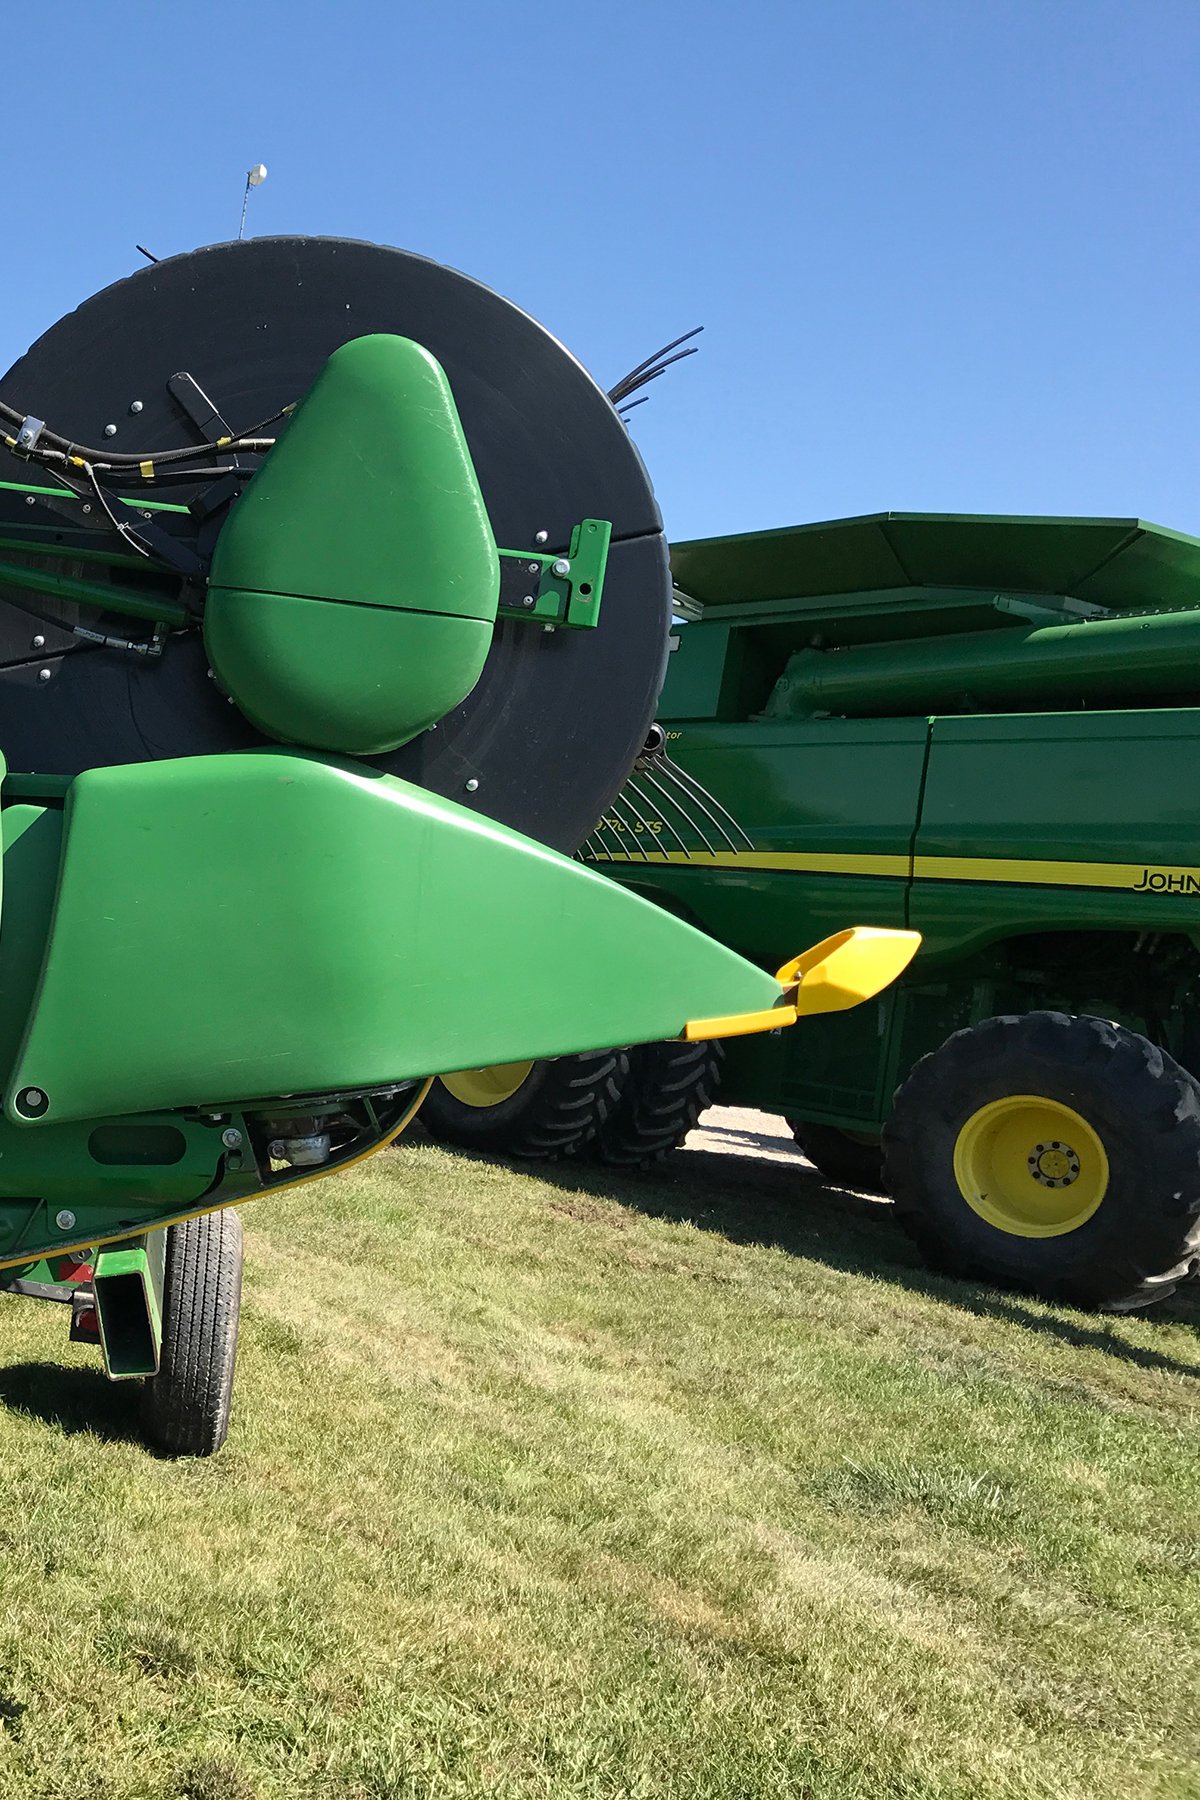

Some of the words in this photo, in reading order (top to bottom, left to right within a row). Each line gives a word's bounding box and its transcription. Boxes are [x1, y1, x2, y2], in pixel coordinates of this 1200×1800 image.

[666, 731, 682, 739] tor
[634, 821, 663, 834] STS
[1133, 869, 1200, 893] JOHN
